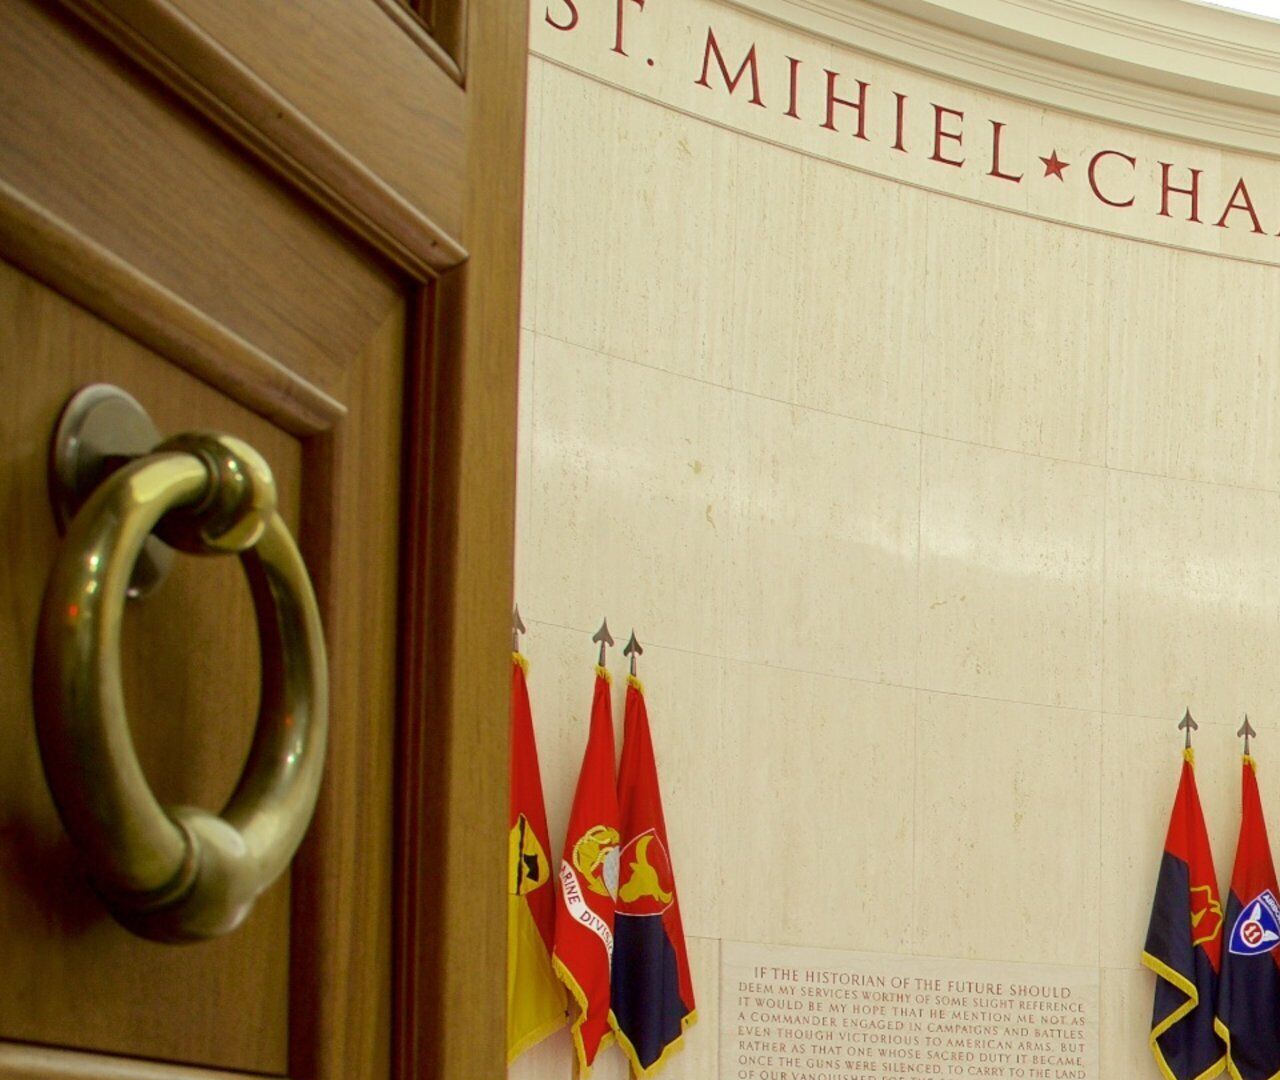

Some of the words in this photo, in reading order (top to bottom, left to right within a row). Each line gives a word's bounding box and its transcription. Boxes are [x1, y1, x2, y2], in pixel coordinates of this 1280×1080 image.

[694, 26, 1024, 184] MIHIEL
[754, 966, 767, 979] IF
[771, 968, 800, 982] THE
[805, 970, 886, 988] HISTORIAN
[891, 977, 911, 989] OF
[915, 978, 941, 991] THE
[948, 980, 1002, 995] FUTURE
[1009, 983, 1072, 998] SHOULD
[738, 997, 750, 1007] IT
[755, 998, 803, 1010] WOULD
[808, 1001, 823, 1011] BE
[829, 1003, 847, 1013] MY
[853, 1004, 886, 1015] HOPE
[893, 1007, 924, 1017] THAT
[930, 1009, 945, 1018] HE
[952, 1010, 1011, 1022] MENTION
[1017, 1013, 1034, 1023] ME
[1040, 1014, 1065, 1025] NOT
[1071, 1016, 1085, 1026] AS
[739, 982, 774, 994] DEEM
[778, 985, 796, 996] MY
[800, 986, 858, 1000] SERVICES
[862, 990, 911, 1003] WORTHY
[915, 994, 930, 1004] OF
[935, 995, 968, 1006] SOME
[973, 997, 1015, 1009] SLIGHT
[1019, 1000, 1084, 1013] REFERENCE
[737, 1012, 746, 1021] A
[750, 1012, 837, 1027] COMMANDER
[843, 1017, 904, 1031] ENGAGED
[909, 1021, 922, 1032] IN
[927, 1022, 998, 1035] CAMPAIGNS
[1003, 1026, 1029, 1037] AND
[738, 1026, 771, 1037] EVEN
[777, 1028, 833, 1041] THOUGH
[839, 1031, 919, 1045] VICTORIOUS
[925, 1036, 942, 1046] TO
[946, 1037, 1013, 1049] AMERICAN
[1061, 1042, 1084, 1052] BUT
[739, 1040, 786, 1053] RATHER
[791, 1043, 806, 1054] AS
[811, 1045, 842, 1055] THAT
[847, 1047, 873, 1057] ONE
[878, 1048, 921, 1059] WHOSE
[927, 1050, 975, 1061] SACRED
[979, 1052, 1011, 1063] DUTY
[1016, 1054, 1028, 1064] IT
